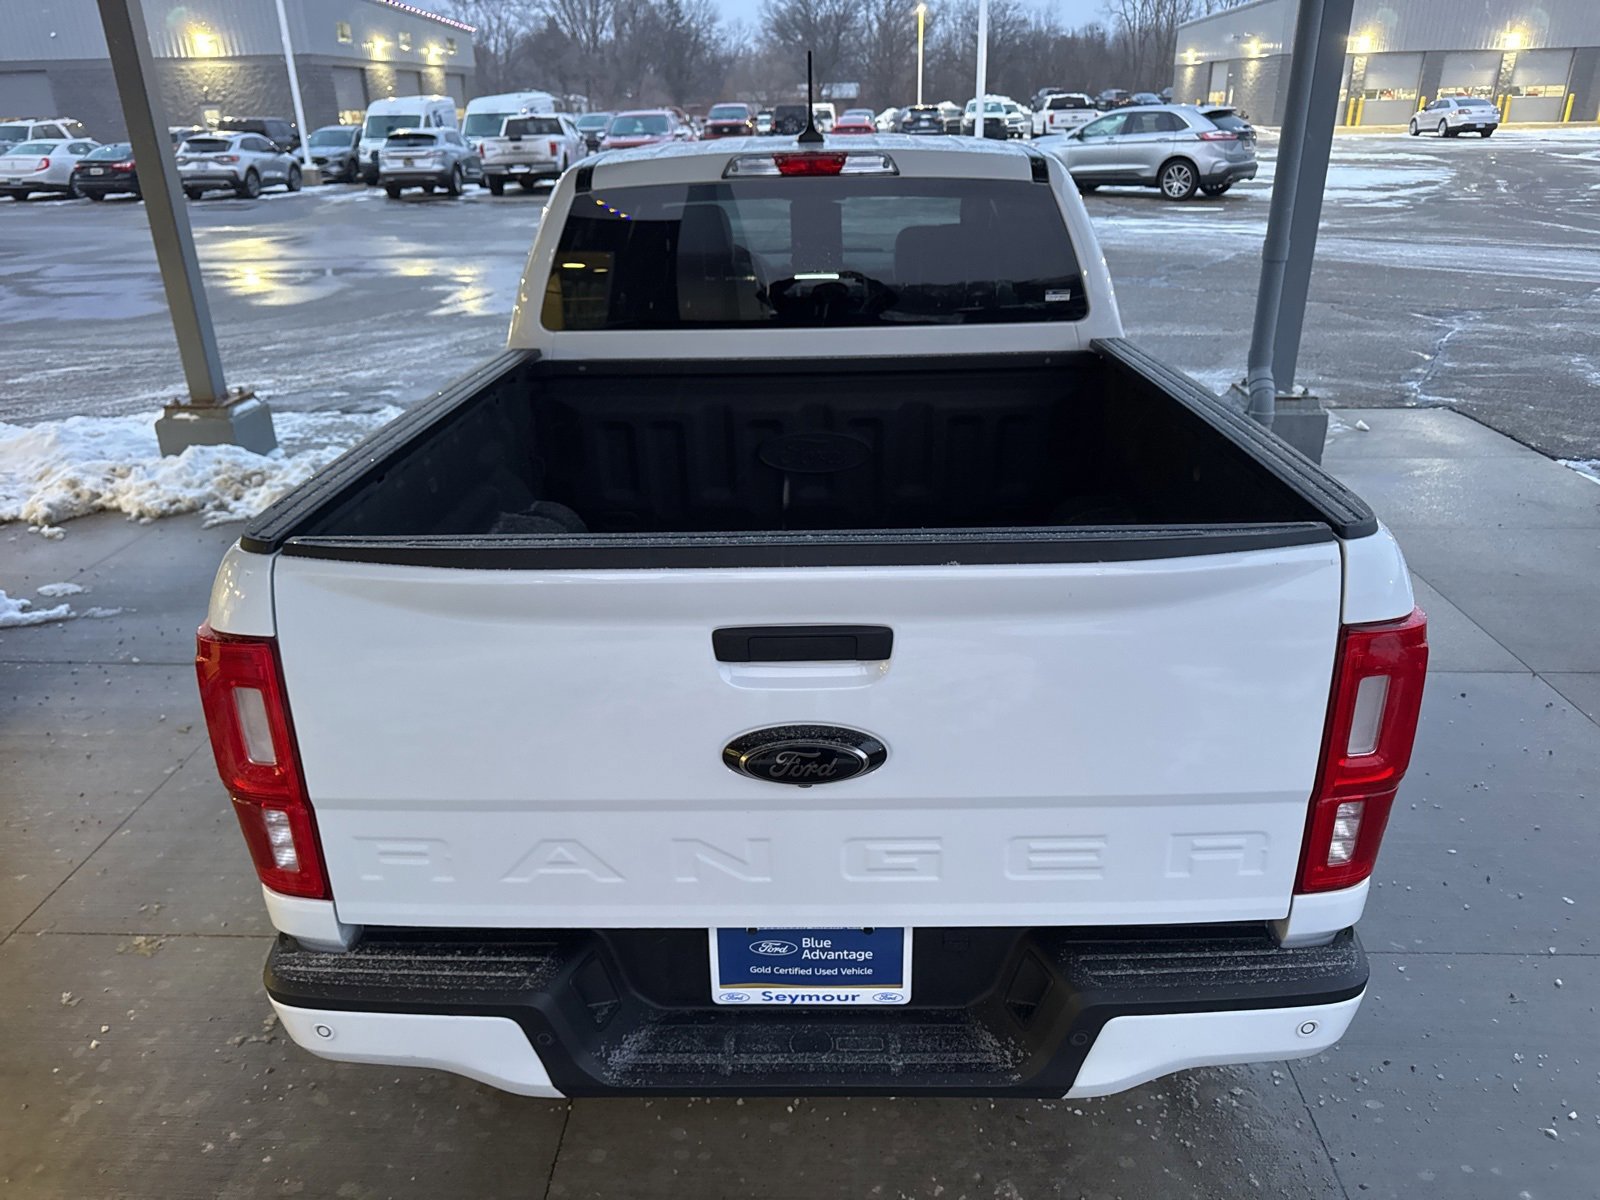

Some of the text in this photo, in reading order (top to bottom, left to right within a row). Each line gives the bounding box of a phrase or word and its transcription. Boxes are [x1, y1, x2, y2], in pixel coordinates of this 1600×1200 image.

[768, 751, 838, 777] Ford
[351, 830, 1269, 884] RANGER
[758, 942, 789, 954] Ford
[802, 937, 832, 948] Blue
[802, 949, 873, 961] Advantage
[750, 966, 873, 976] Gold Certified Used Vehicle
[725, 993, 744, 1002] Ford
[761, 990, 860, 1004] Seymour
[879, 993, 898, 1002] Ford
